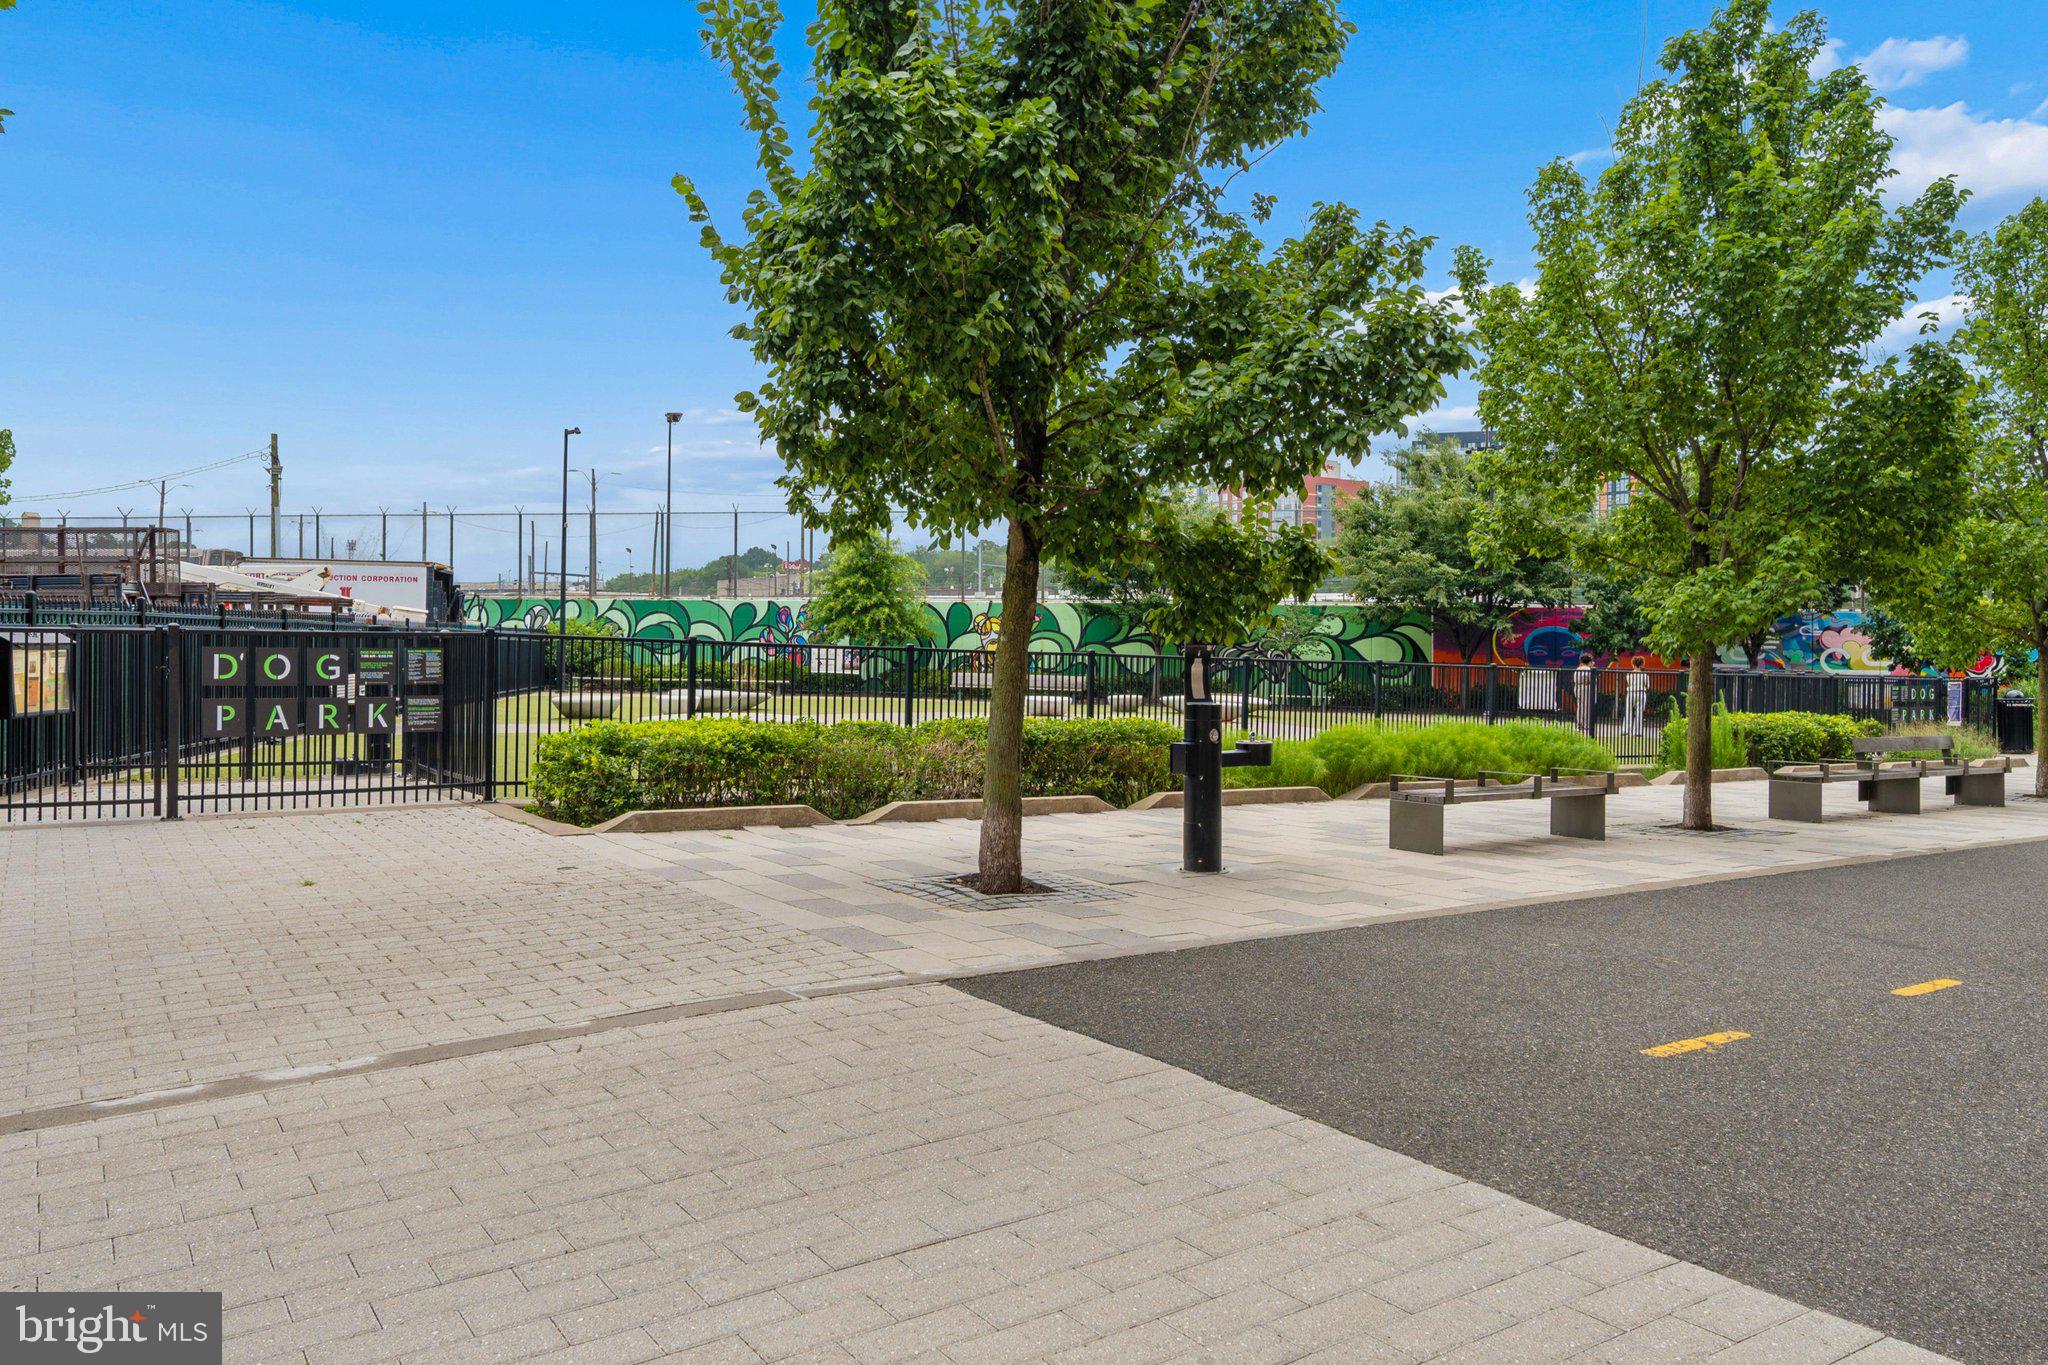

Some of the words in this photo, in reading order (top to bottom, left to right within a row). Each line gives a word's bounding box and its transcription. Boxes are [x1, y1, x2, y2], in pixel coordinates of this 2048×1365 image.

[361, 575, 418, 583] CORPORATION
[213, 654, 341, 680] DOG
[1911, 688, 1934, 700] DOG
[216, 703, 388, 731] PARK
[1902, 709, 1934, 720] PARK
